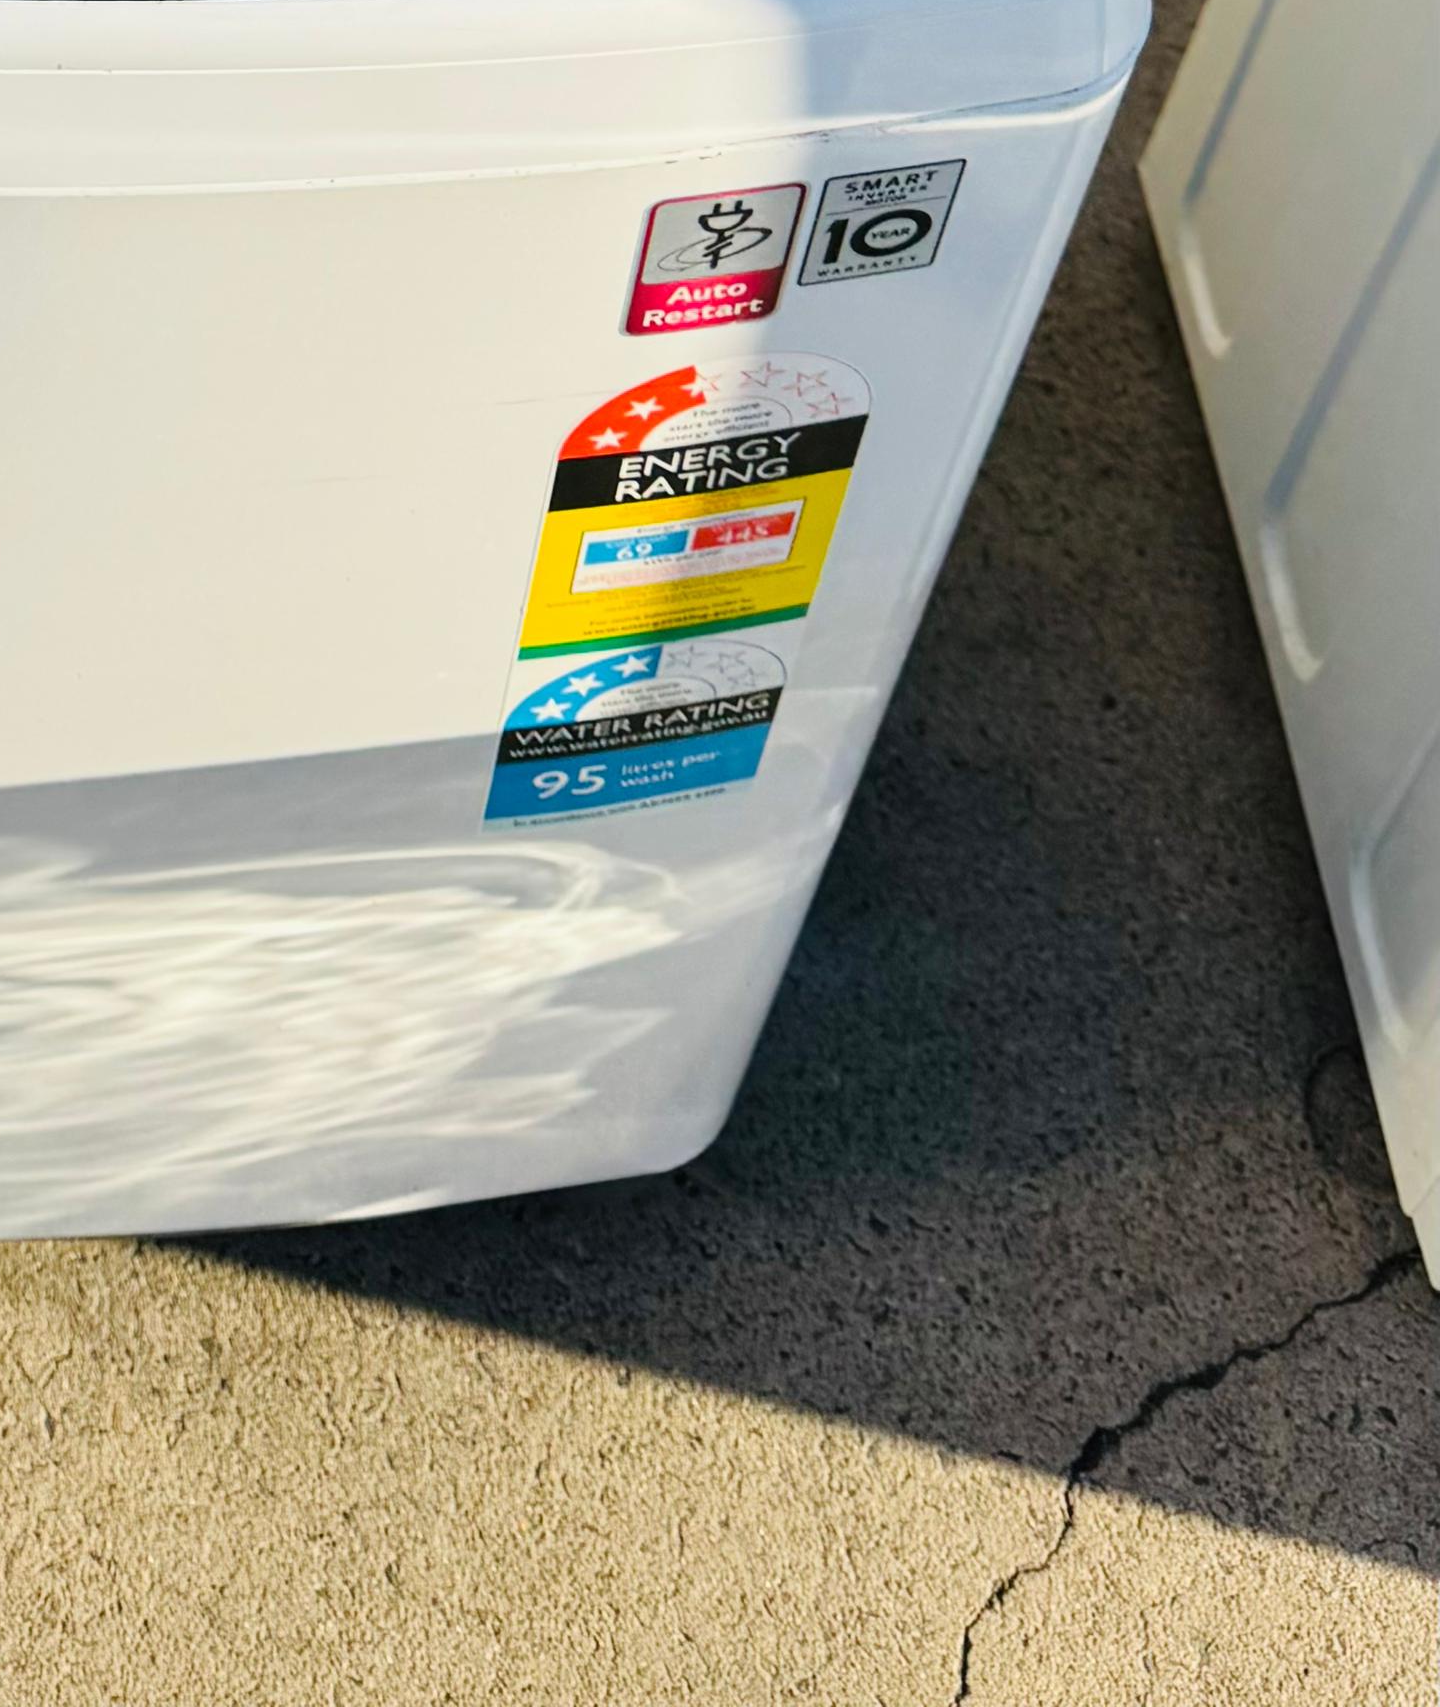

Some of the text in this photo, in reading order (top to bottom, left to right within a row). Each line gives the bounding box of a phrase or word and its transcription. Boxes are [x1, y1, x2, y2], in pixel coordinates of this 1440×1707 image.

[844, 169, 939, 195] SMART
[823, 208, 933, 266] 10
[871, 226, 911, 240] YEAR
[817, 255, 917, 278] WARRANTY
[666, 282, 748, 306] Auto
[642, 297, 764, 328] Restart
[618, 431, 802, 479] ENERGY
[614, 456, 791, 503] RATING
[616, 541, 654, 561] 69
[514, 717, 632, 747] WATER
[644, 692, 771, 728] RATING
[532, 765, 609, 800] 95
